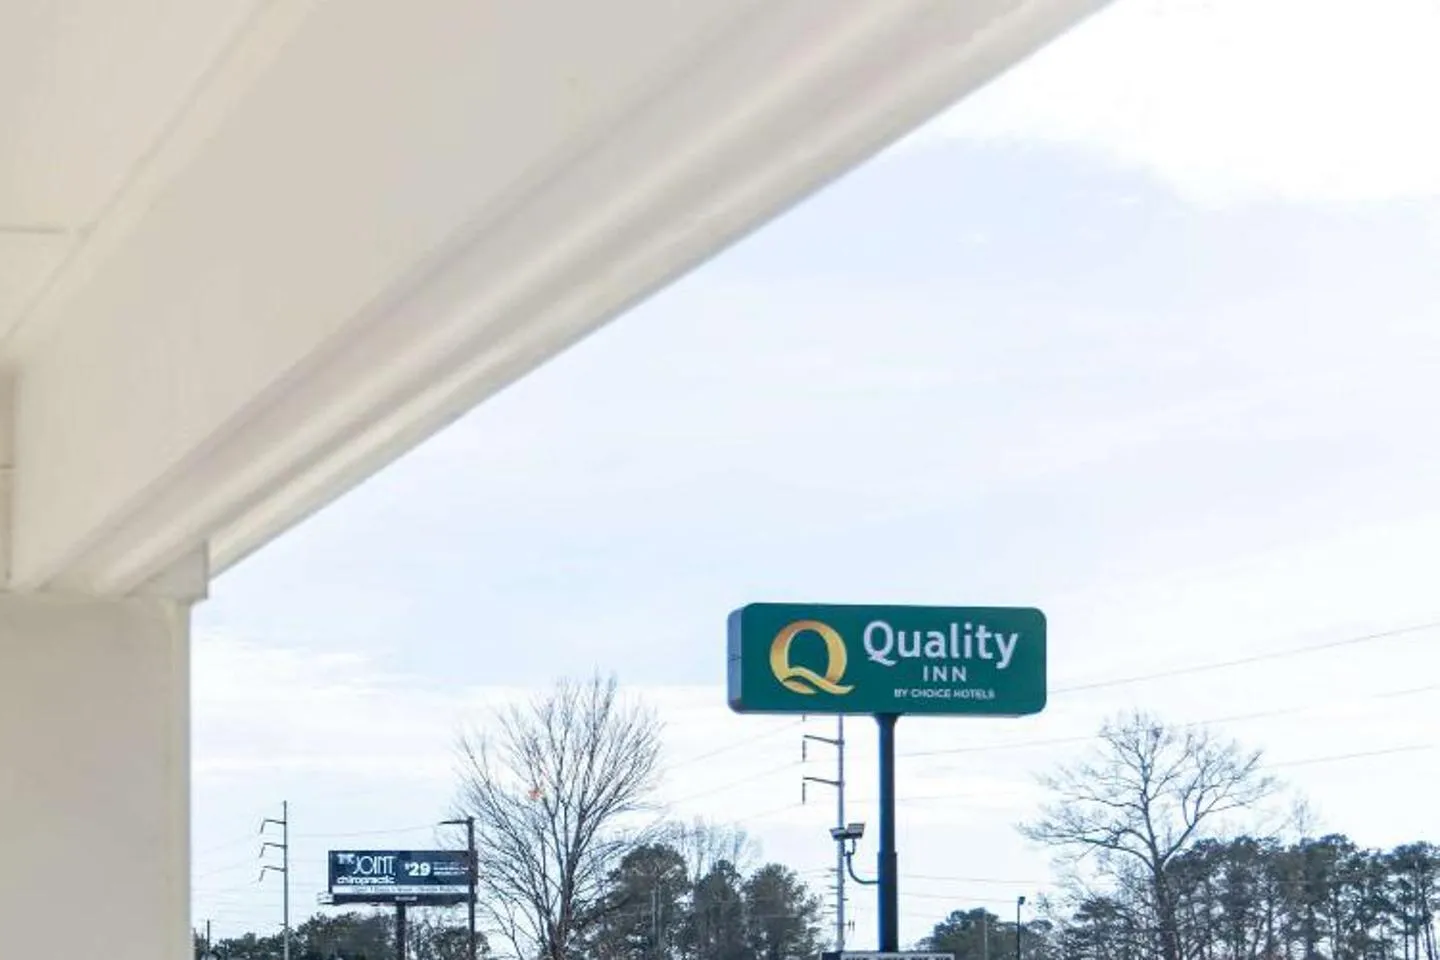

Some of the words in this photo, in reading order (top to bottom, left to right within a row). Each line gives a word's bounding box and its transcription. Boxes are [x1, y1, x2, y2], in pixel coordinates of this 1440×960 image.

[862, 619, 1019, 669] Quality
[923, 665, 967, 682] INN
[894, 688, 909, 698] BY
[911, 688, 951, 698] CHOICE
[954, 689, 995, 699] HOTELS
[353, 855, 397, 875] JOINT
[337, 875, 395, 885] chiropractic
